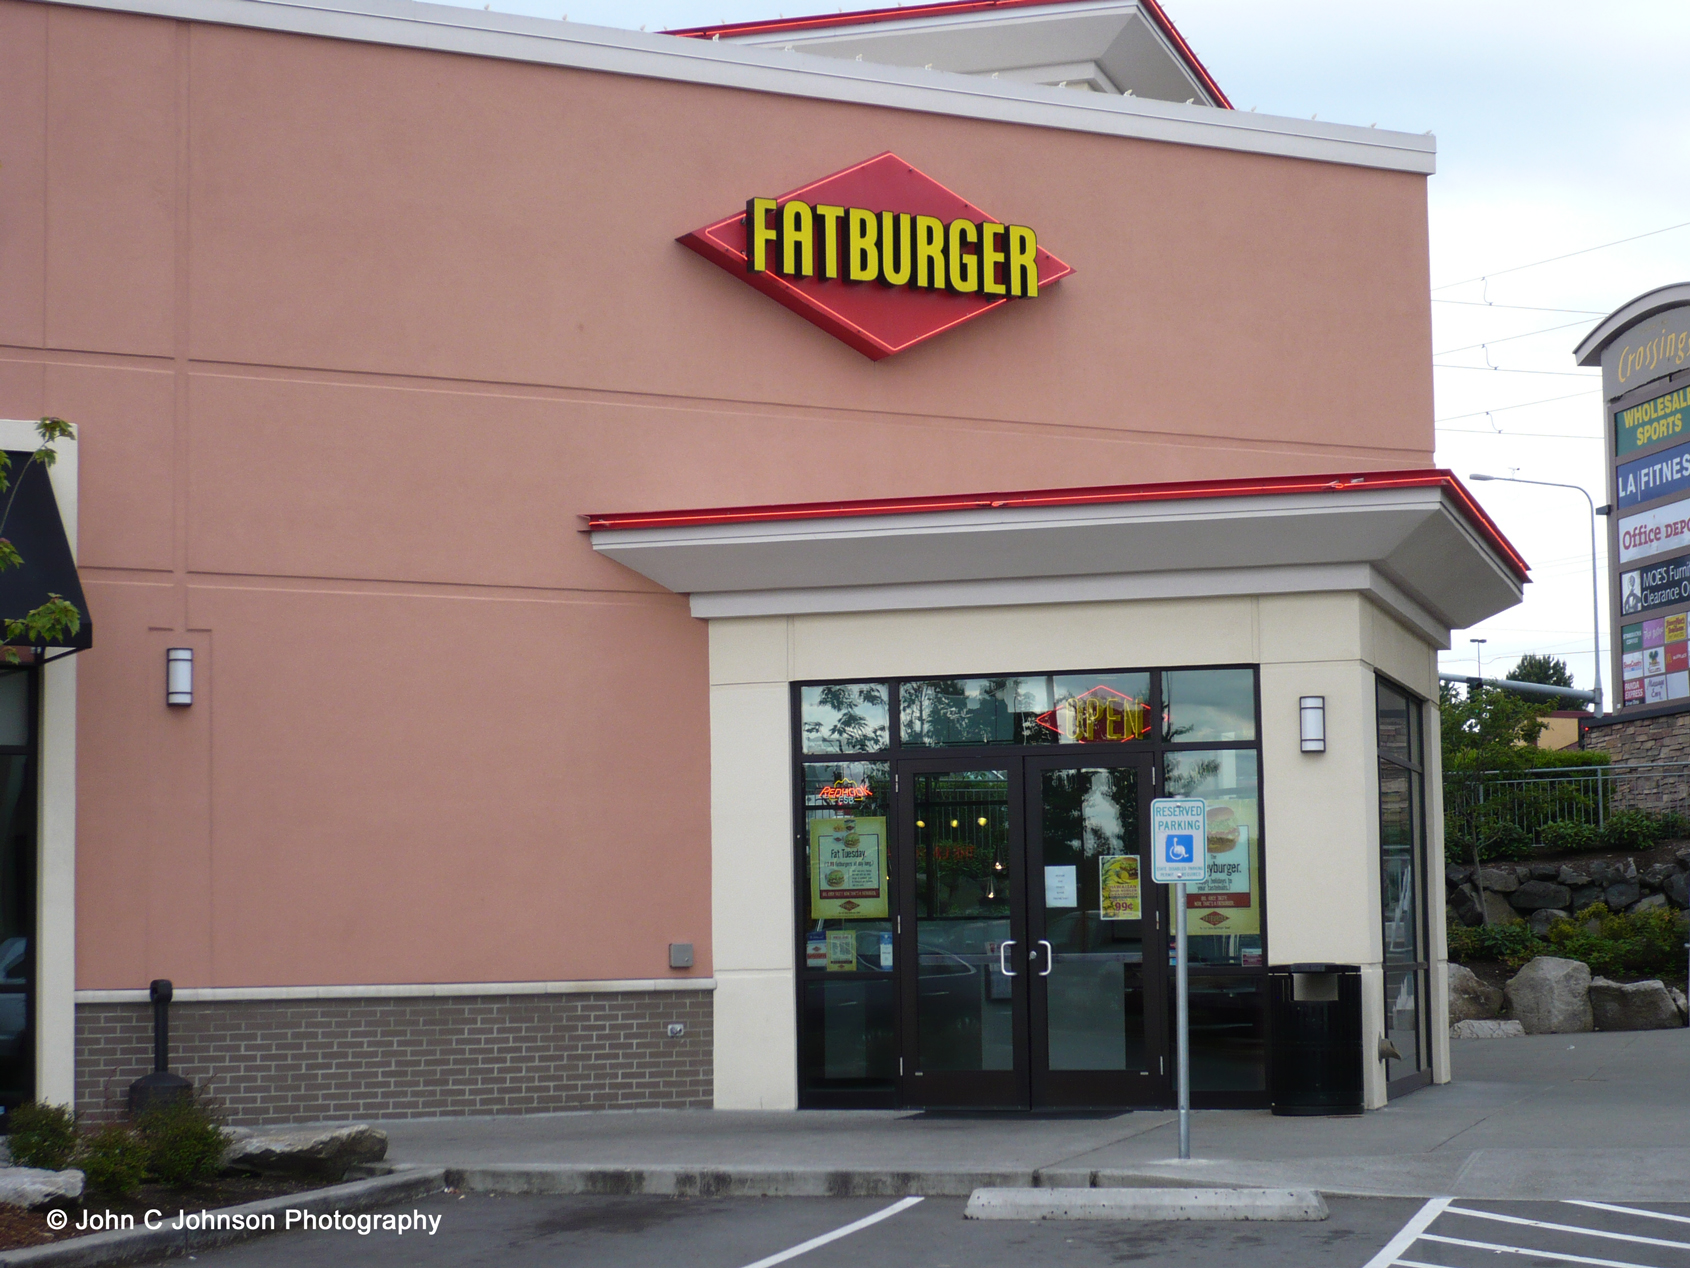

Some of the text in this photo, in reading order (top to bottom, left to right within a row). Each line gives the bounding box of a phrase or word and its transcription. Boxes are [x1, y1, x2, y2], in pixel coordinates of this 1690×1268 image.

[752, 197, 1039, 298] FATBURGER
[1636, 413, 1683, 446] SPORTS
[1622, 524, 1661, 550] Office
[1643, 566, 1668, 588] MOE'S
[1642, 586, 1680, 606] Clearance
[1625, 681, 1640, 691] PANDA
[1625, 688, 1644, 700] EXPRESS
[1065, 697, 1144, 740] OPEN
[819, 785, 873, 798] REDHOOK
[838, 796, 855, 804] ESB
[1155, 805, 1203, 817] RESERVED
[1158, 819, 1201, 831] PARKING
[830, 848, 840, 859] Fat
[1114, 902, 1134, 911] 99¢
